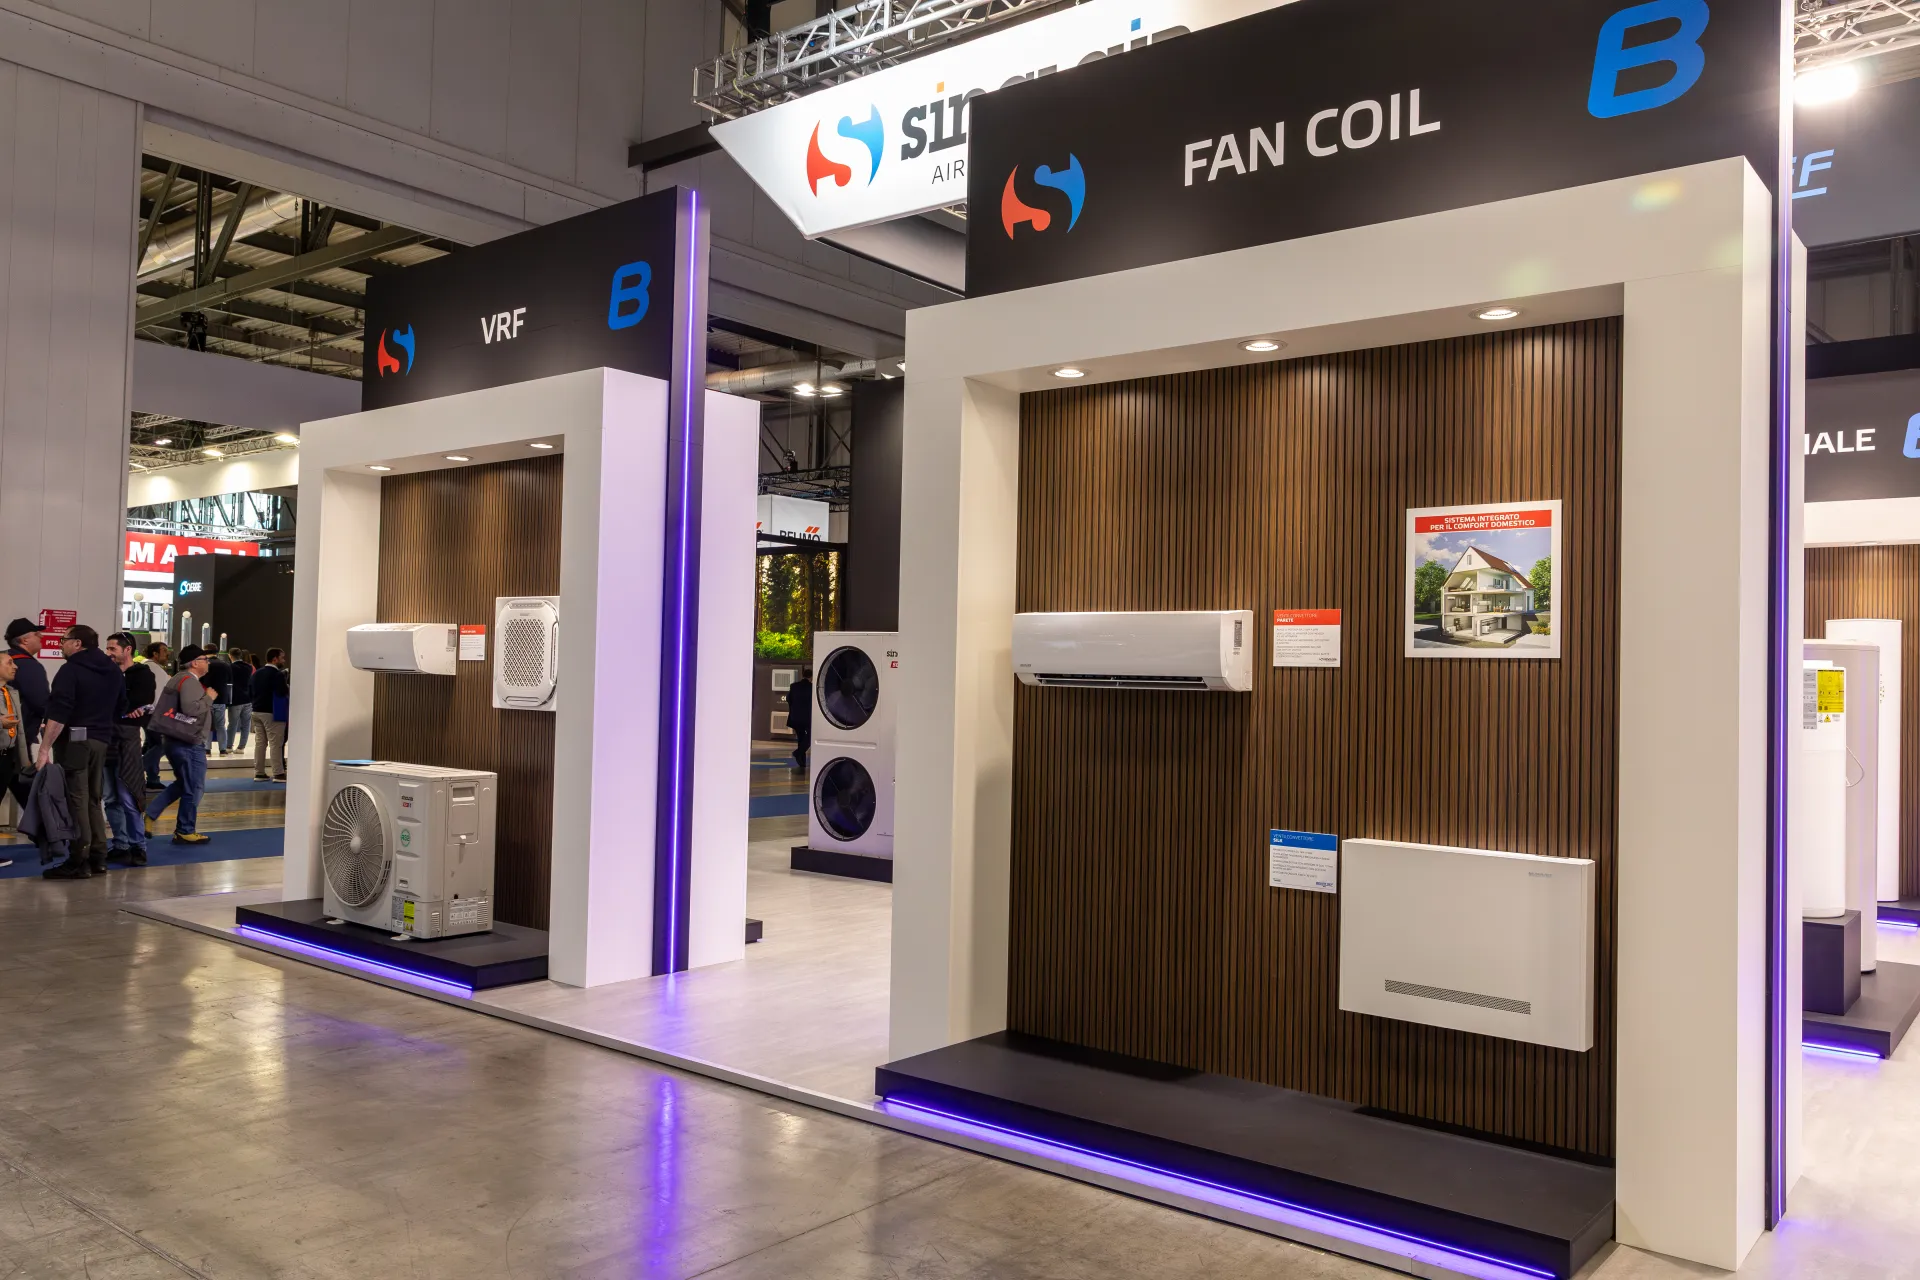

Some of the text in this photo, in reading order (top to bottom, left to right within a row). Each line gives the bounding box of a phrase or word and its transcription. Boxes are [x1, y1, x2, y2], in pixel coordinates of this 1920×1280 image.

[1184, 88, 1441, 187] FAN COIL
[931, 159, 965, 185] AIR
[481, 307, 527, 345] VRF
[1444, 513, 1520, 524] SISTEMA INTEGRATO
[1453, 521, 1489, 530] COMFORT
[1490, 519, 1535, 528] DOMESTICO
